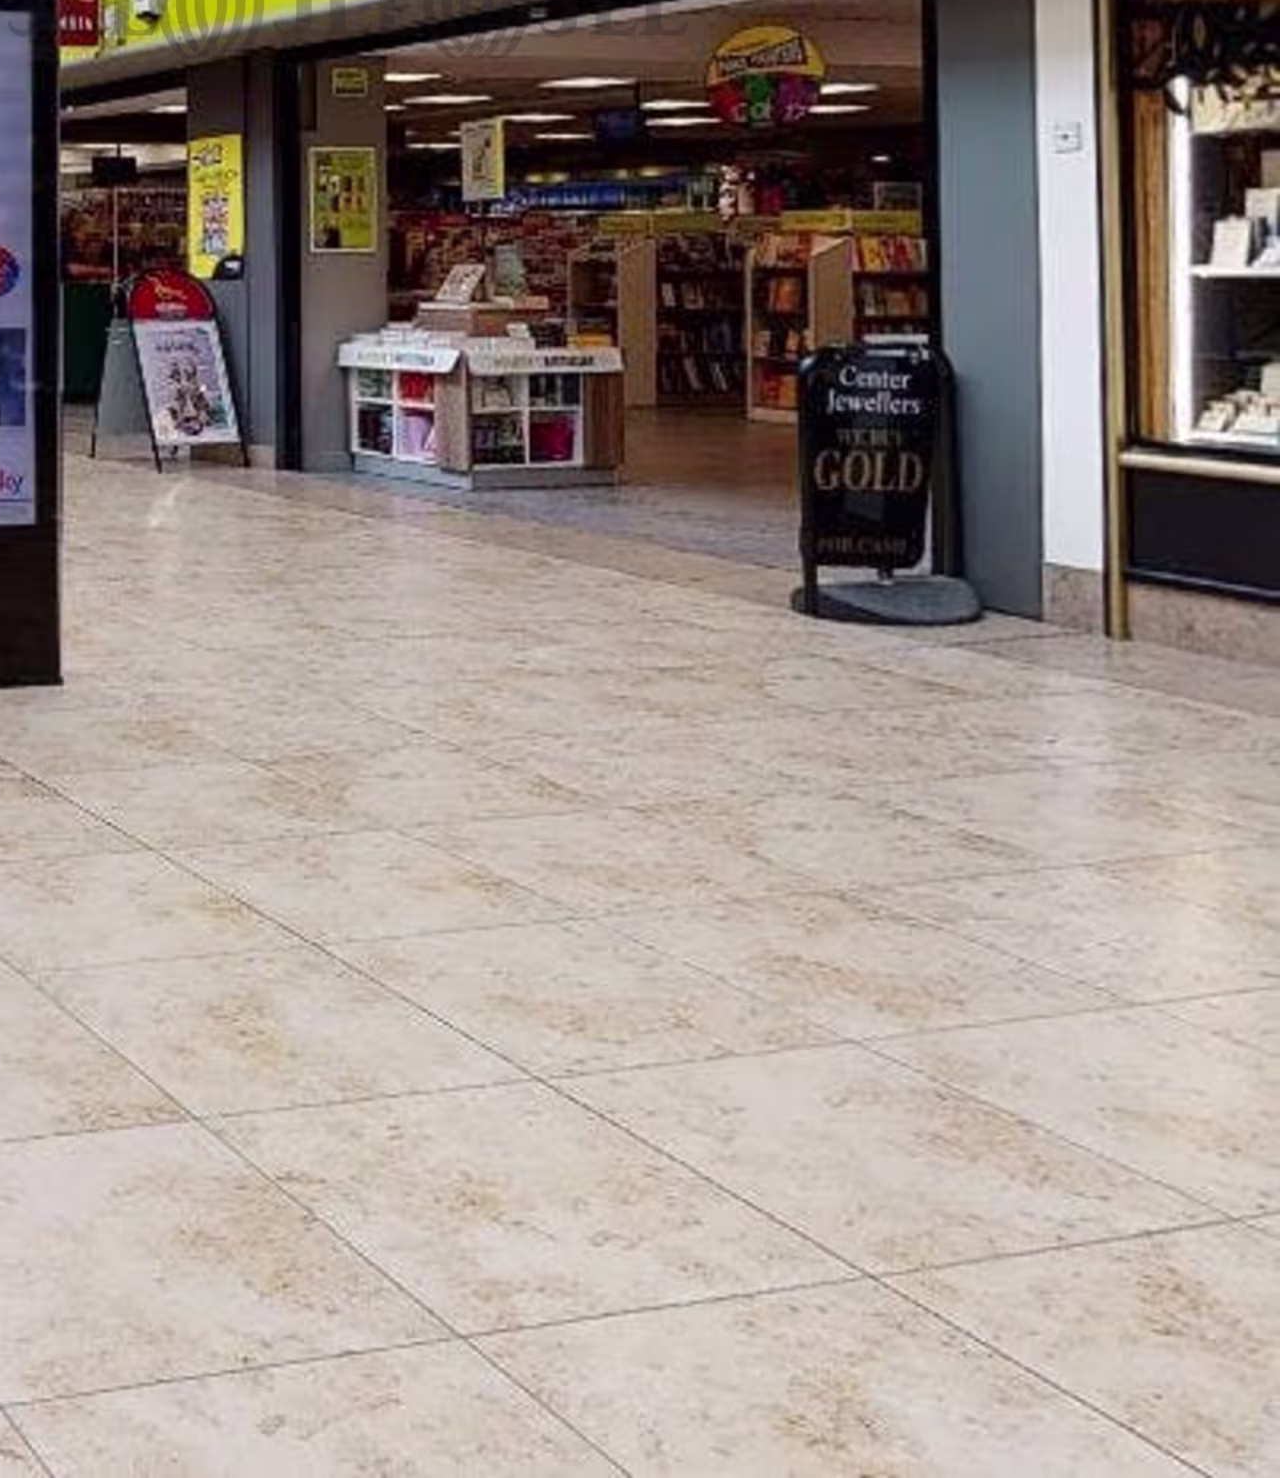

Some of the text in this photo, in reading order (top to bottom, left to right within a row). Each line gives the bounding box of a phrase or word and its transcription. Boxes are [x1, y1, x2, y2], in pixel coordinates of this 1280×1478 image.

[839, 365, 913, 390] Center
[826, 389, 921, 415] Jewellers
[814, 449, 924, 492] GOLD
